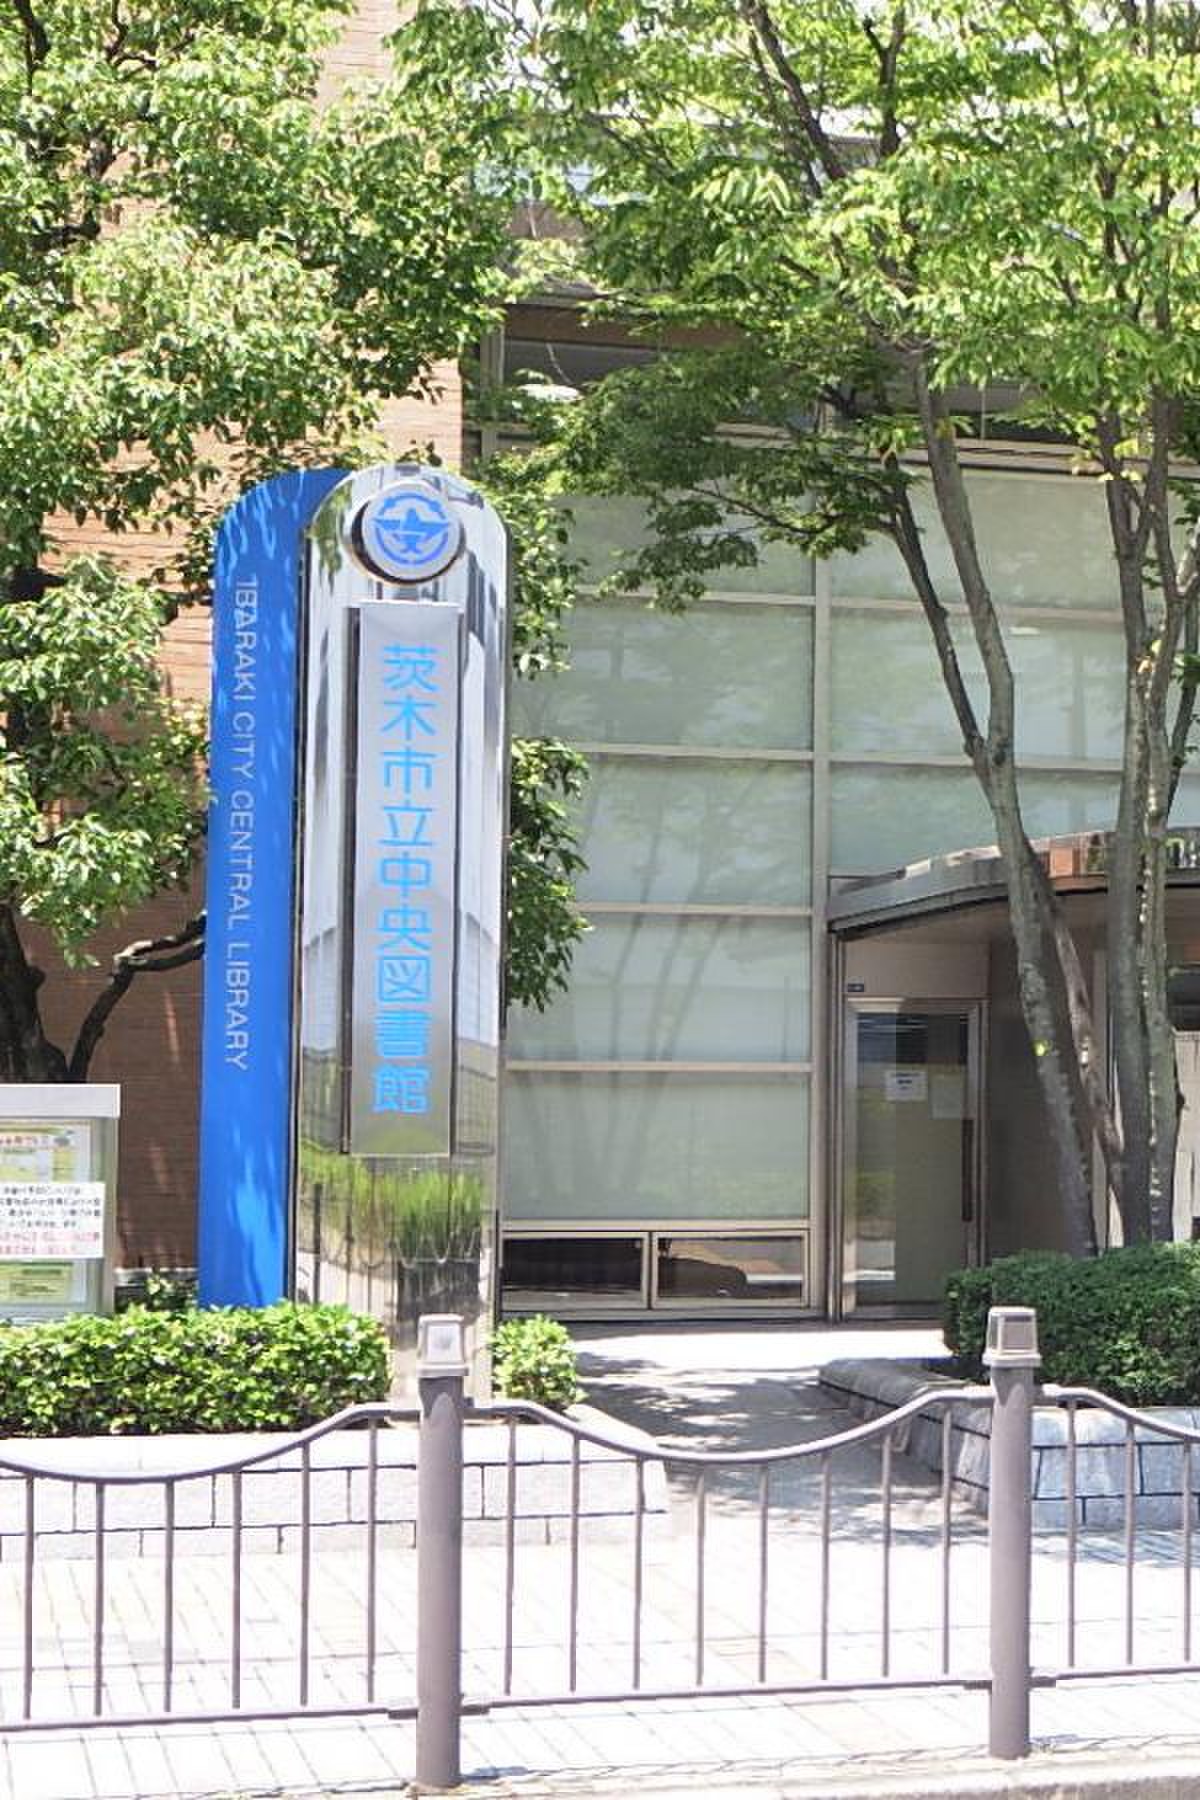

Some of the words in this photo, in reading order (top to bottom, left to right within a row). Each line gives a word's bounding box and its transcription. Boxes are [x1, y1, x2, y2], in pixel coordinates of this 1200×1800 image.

[231, 576, 258, 701] IBARAKI
[230, 711, 257, 780] CITY
[226, 789, 256, 932] CENTRAL
[375, 643, 439, 1115] 茨木市立中央図書館
[223, 943, 252, 1071] LIBRARY
